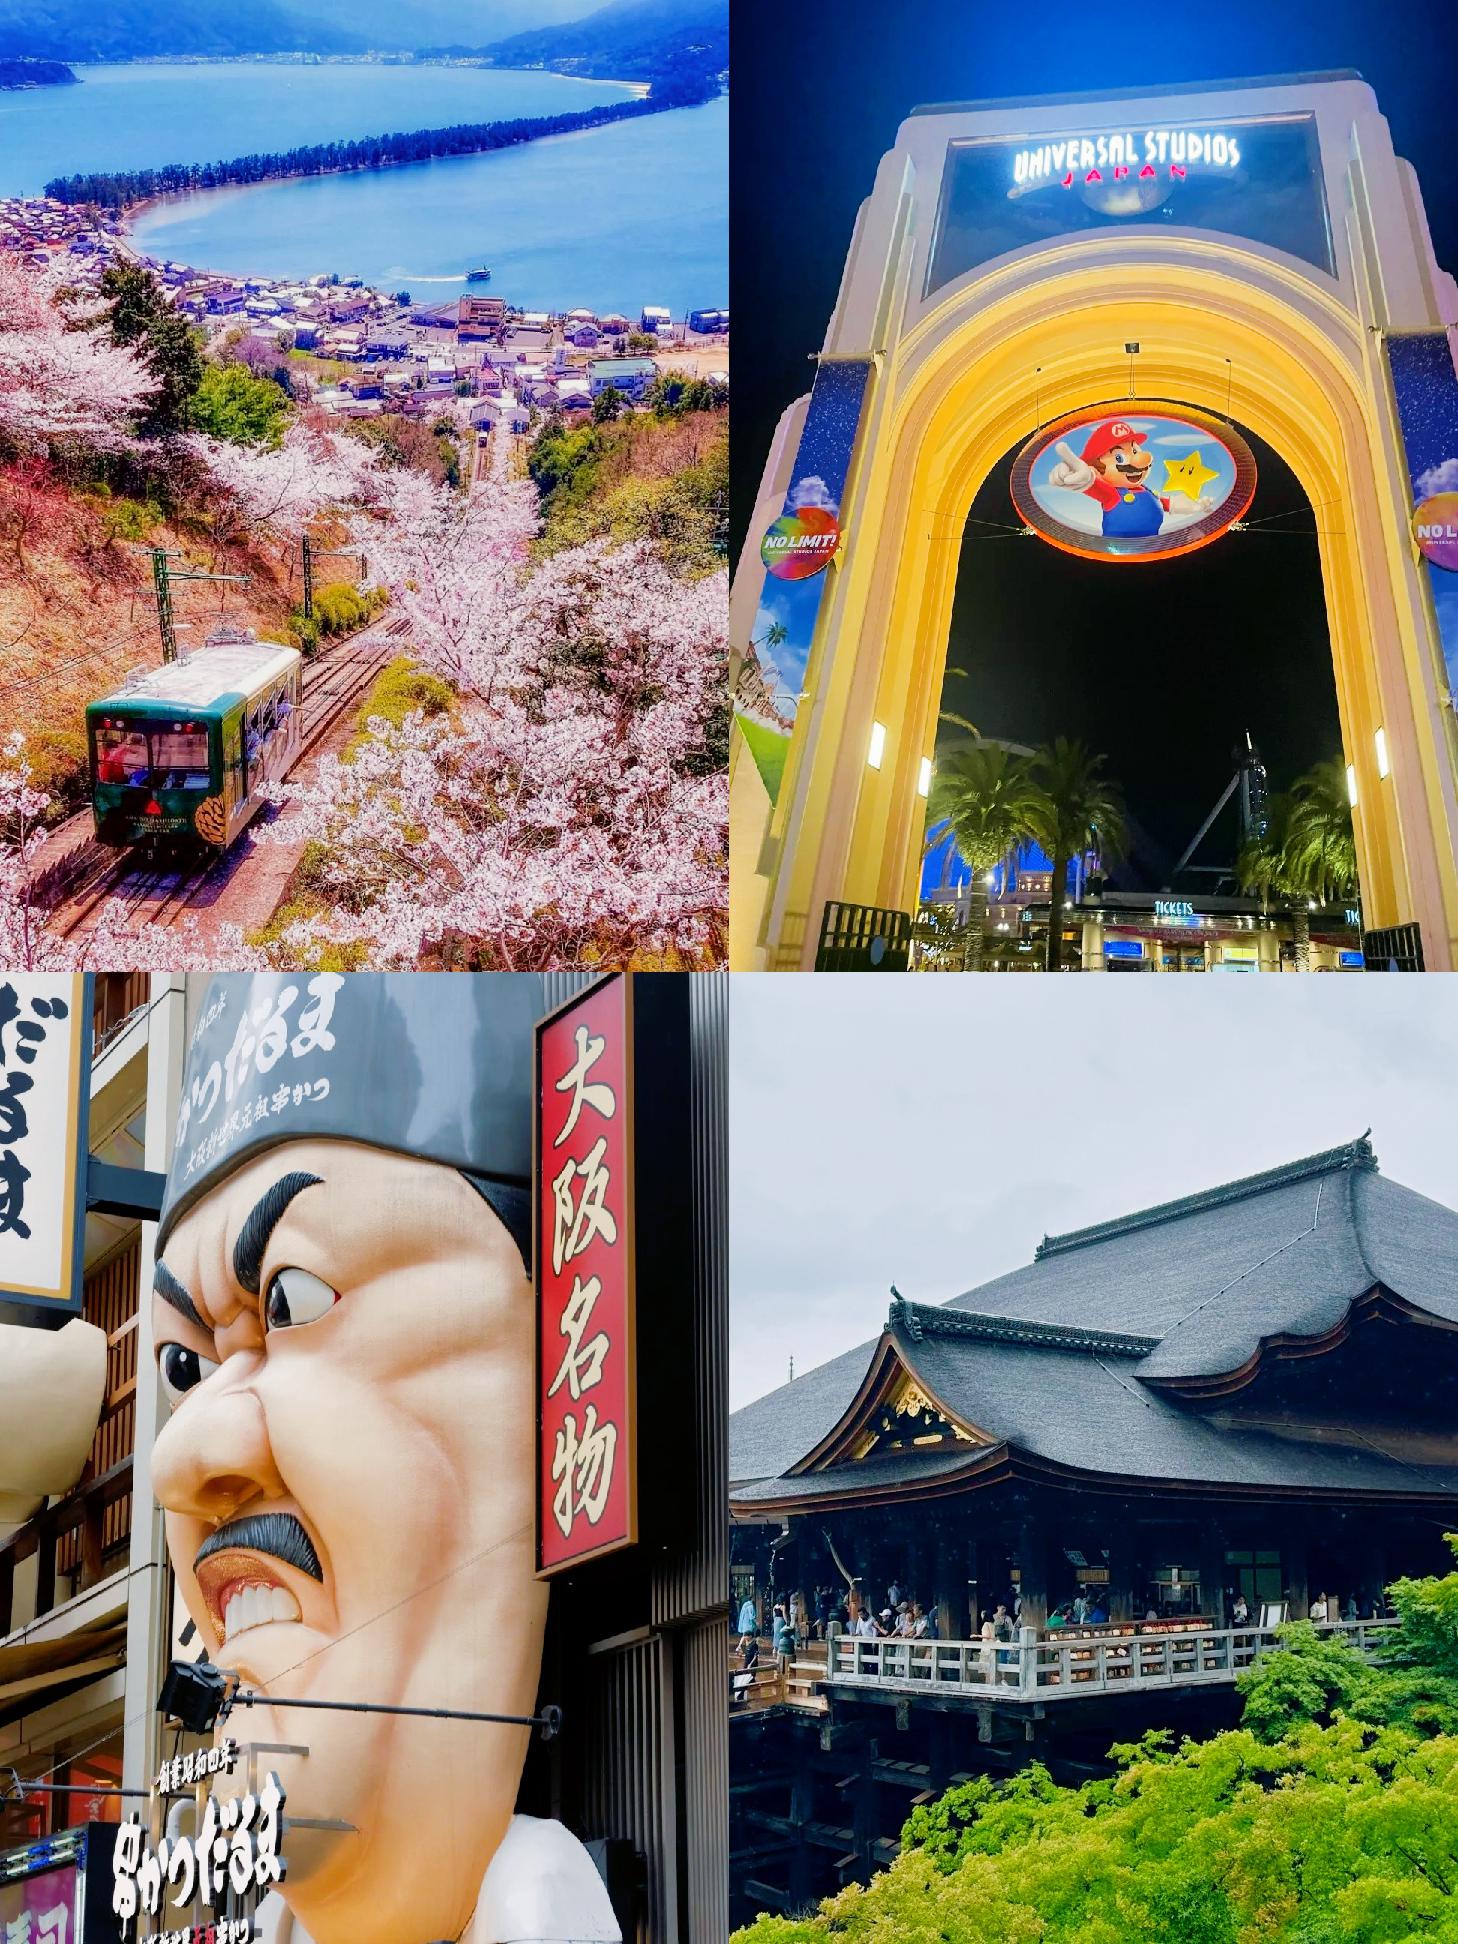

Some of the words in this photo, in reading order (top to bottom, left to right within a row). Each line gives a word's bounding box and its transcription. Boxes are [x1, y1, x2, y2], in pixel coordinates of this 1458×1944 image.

[1013, 132, 1139, 183] UNIVERSAL
[1144, 130, 1241, 168] STUDIOS
[1061, 164, 1186, 186] JAPAN
[765, 535, 788, 548] NO
[787, 534, 837, 548] LIMIT!
[1418, 524, 1443, 538] NO
[1155, 901, 1193, 915] TICKETS
[547, 1025, 619, 1539] 大阪名物
[113, 1771, 284, 1941] 串かつだるま
